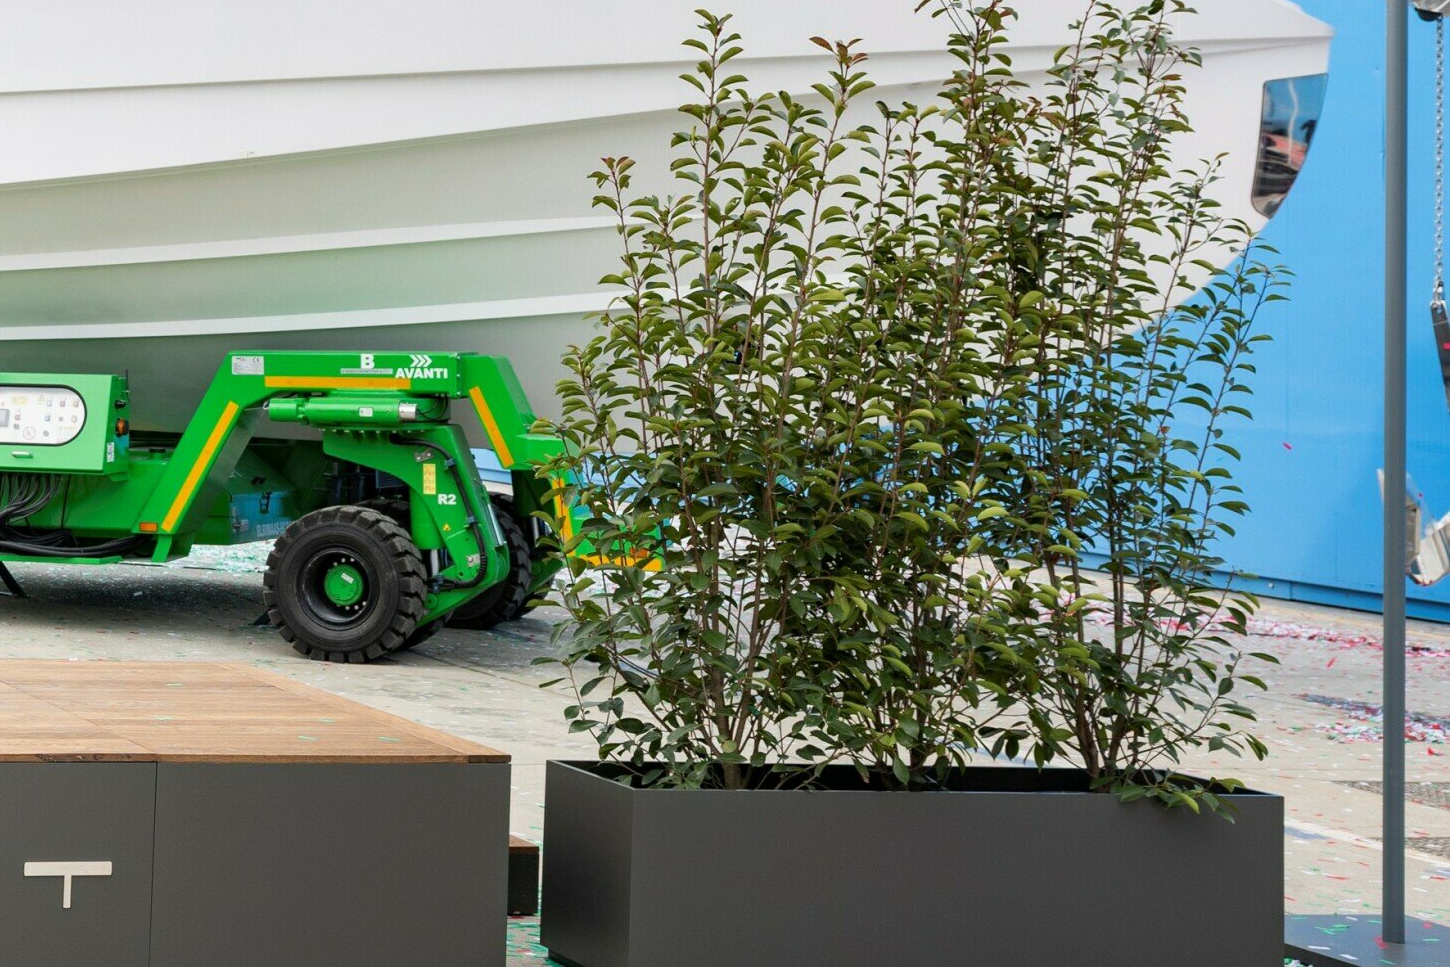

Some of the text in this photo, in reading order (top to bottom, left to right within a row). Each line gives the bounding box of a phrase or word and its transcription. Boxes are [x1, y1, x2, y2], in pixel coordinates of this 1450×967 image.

[360, 353, 375, 369] B
[395, 367, 448, 379] AVANTI
[437, 494, 457, 505] R2
